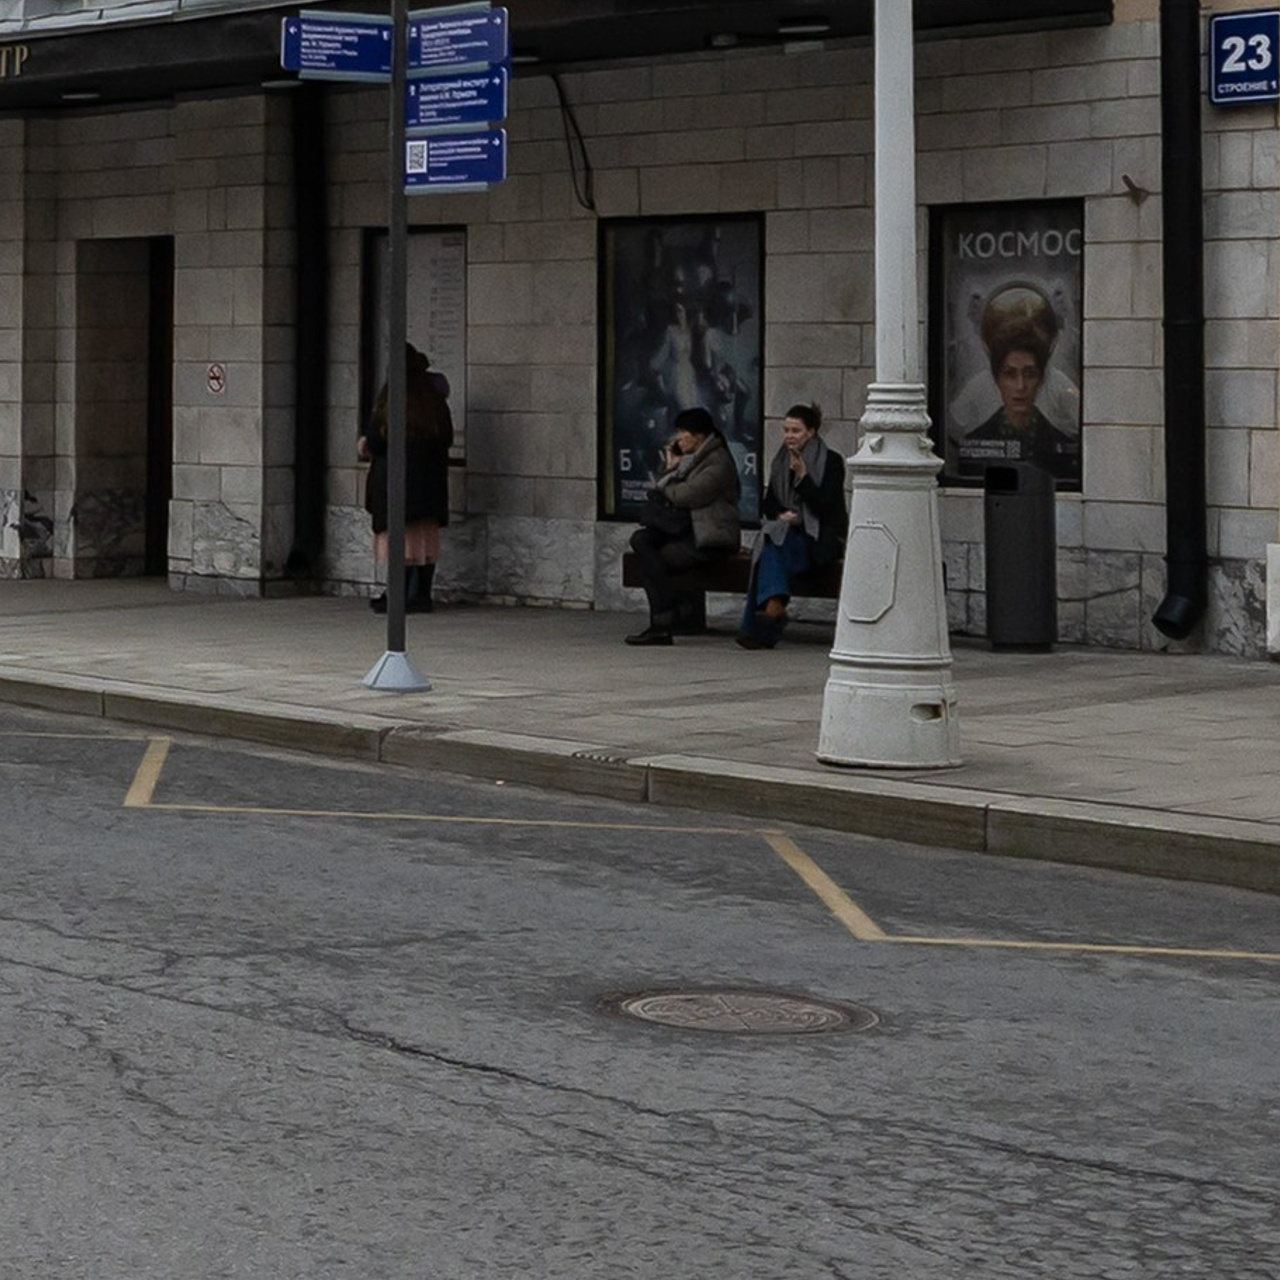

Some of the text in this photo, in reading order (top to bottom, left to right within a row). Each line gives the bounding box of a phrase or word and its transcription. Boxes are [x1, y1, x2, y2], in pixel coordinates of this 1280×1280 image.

[1221, 34, 1272, 73] 23
[1271, 80, 1277, 90] 1
[958, 229, 1081, 259] КОСМОС
